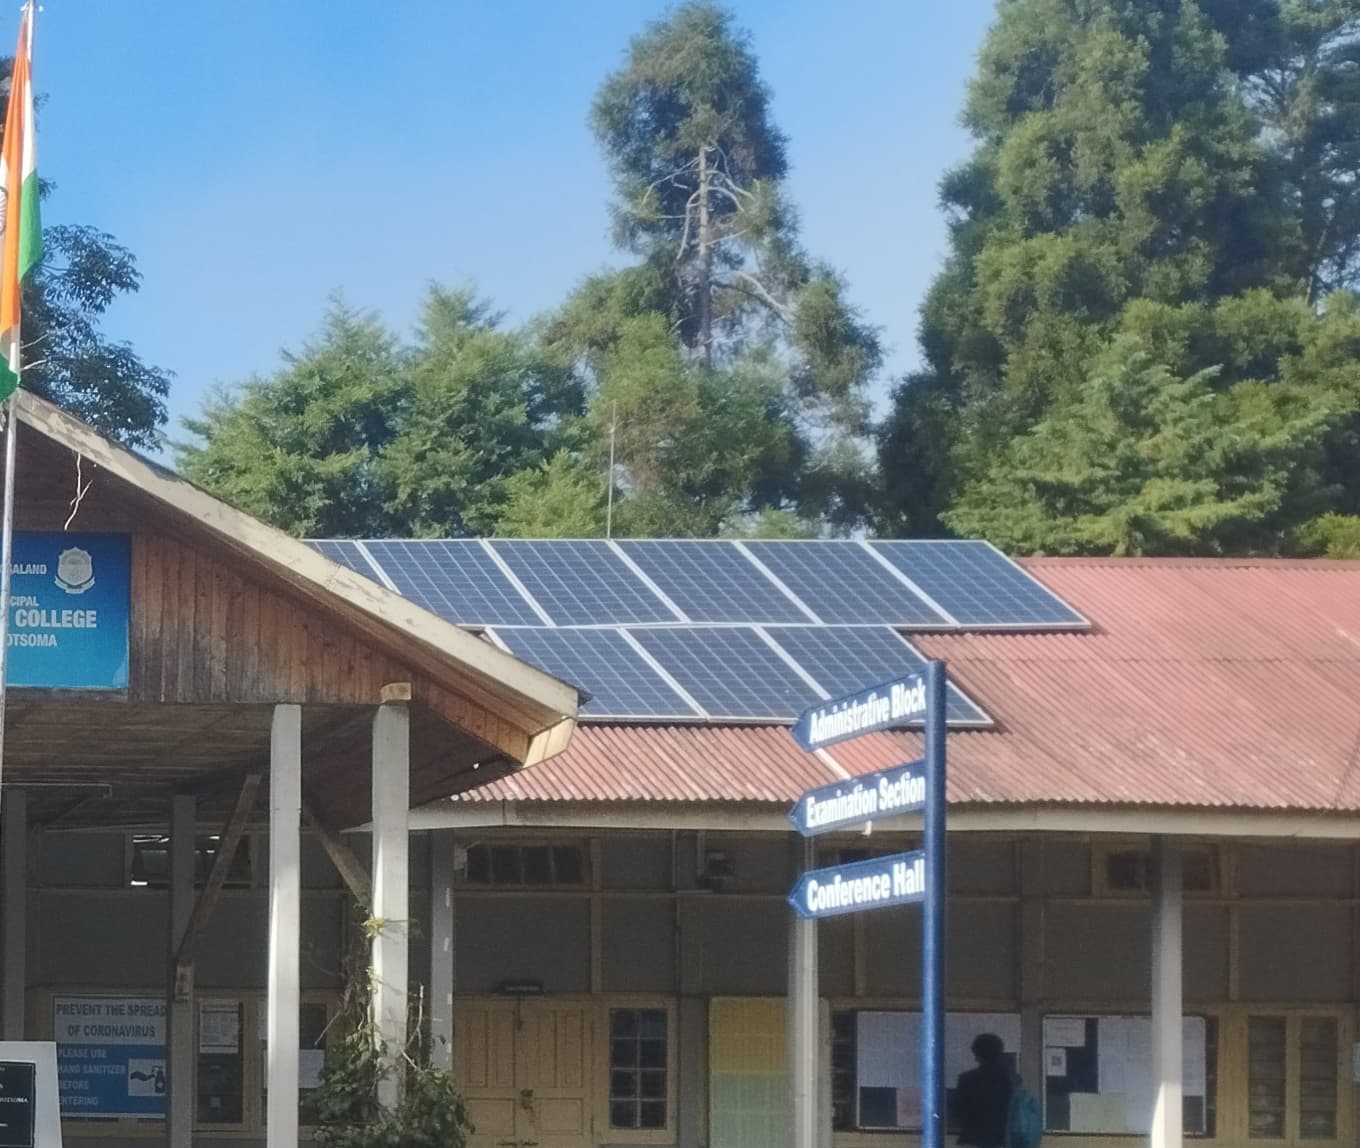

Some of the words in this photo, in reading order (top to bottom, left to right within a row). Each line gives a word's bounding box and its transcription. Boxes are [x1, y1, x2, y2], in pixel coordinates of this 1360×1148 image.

[15, 609, 97, 628] COLLEGE
[808, 692, 890, 744] Administrative
[891, 678, 927, 719] Block
[806, 783, 877, 828] Examination
[878, 771, 926, 811] Section
[806, 869, 891, 912] Conference
[892, 858, 926, 896] Hall
[56, 1003, 101, 1016] PREVENT
[105, 1004, 125, 1016] THE
[127, 1004, 168, 1017] SPREAD
[67, 1024, 81, 1037] OF
[83, 1024, 156, 1037] CORONAVIRUS
[83, 1064, 127, 1074] SANITIZER
